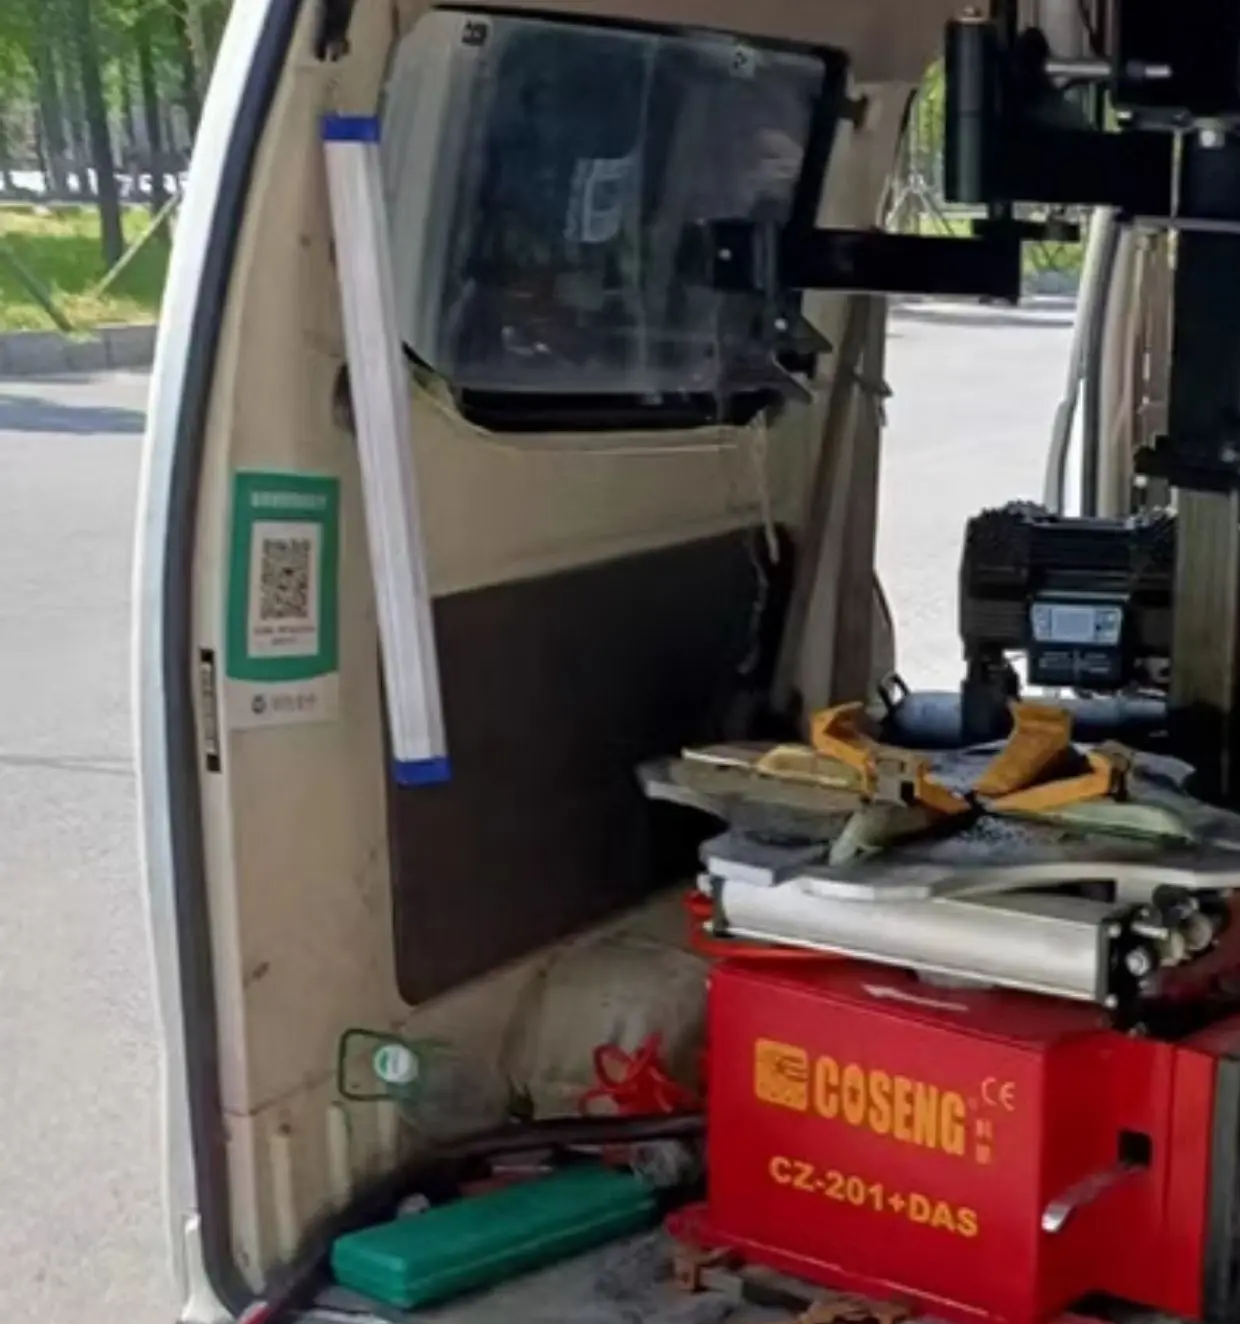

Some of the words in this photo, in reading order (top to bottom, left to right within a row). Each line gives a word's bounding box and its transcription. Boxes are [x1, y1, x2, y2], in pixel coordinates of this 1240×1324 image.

[814, 1054, 966, 1156] COSENG
[981, 1076, 1016, 1112] CE
[768, 1155, 979, 1238] CZ-201+DAS
